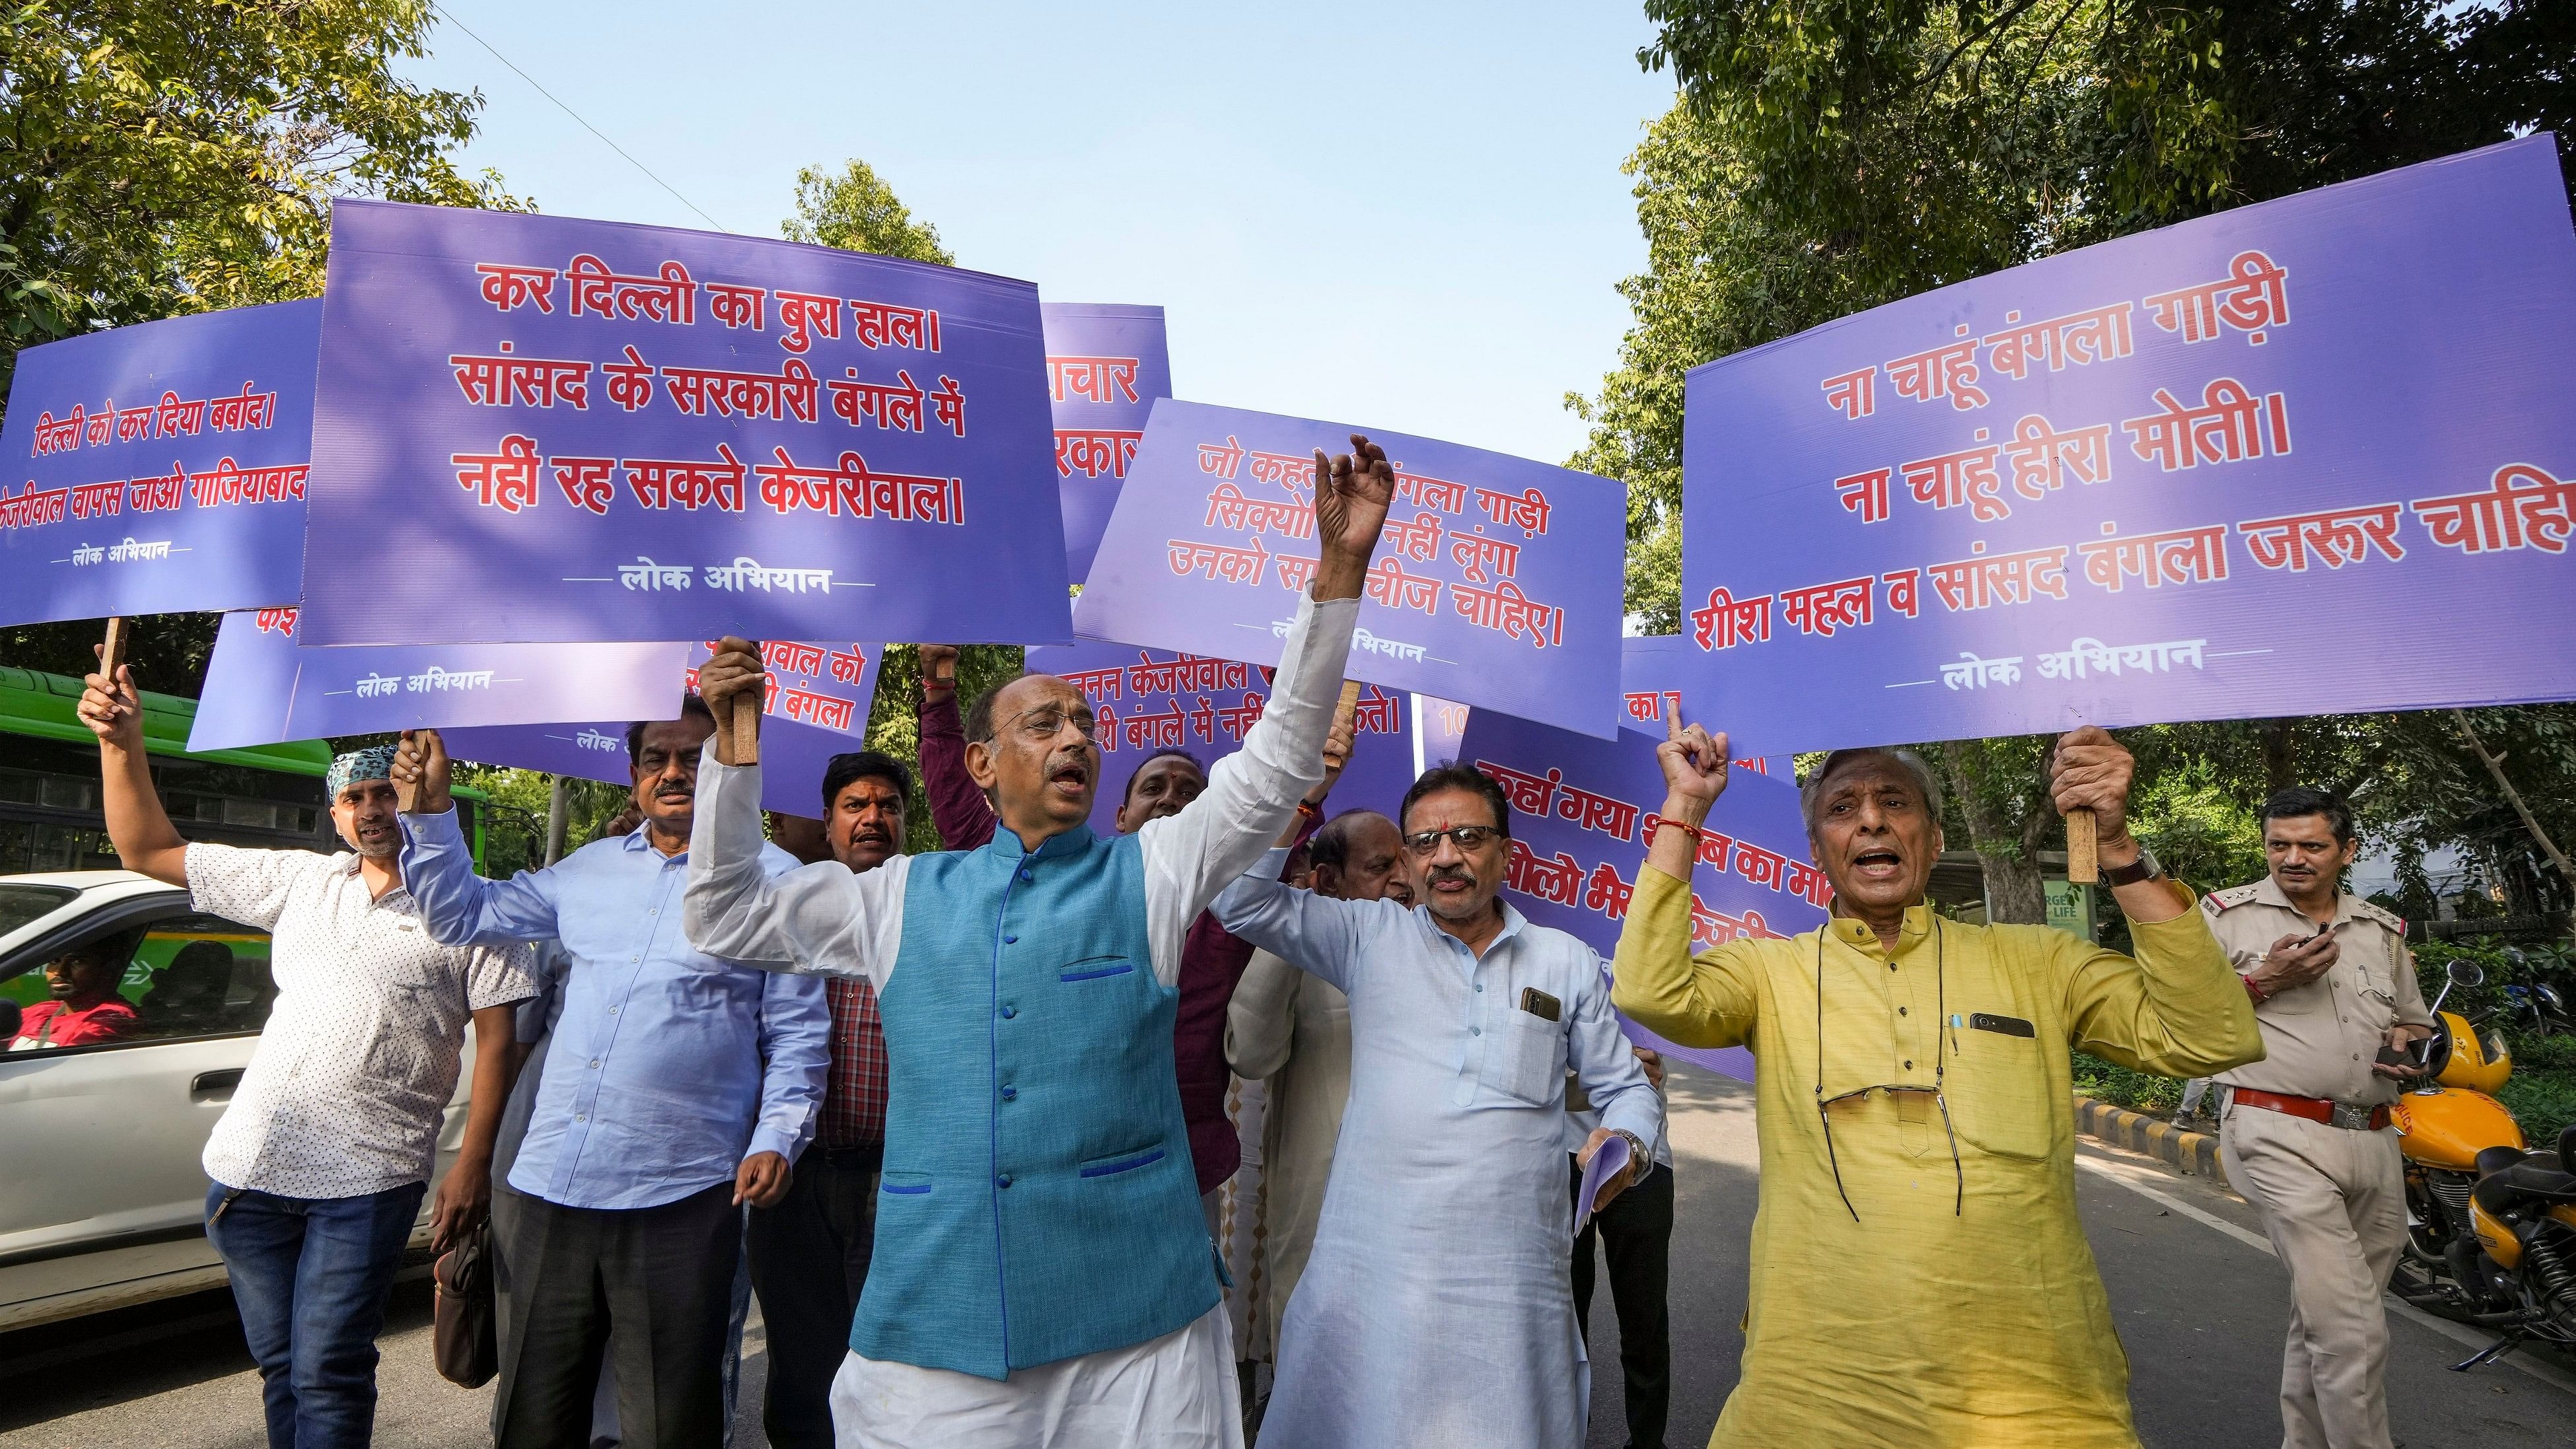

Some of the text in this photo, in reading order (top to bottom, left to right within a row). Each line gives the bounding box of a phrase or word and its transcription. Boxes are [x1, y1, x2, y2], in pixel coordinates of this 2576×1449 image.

[475, 253, 941, 354] कर दिल्ली का बुरा हाल।
[1822, 249, 2290, 421] ना चाहूं बंगला गाड़ी
[448, 341, 966, 439] सांसद के सरकारी बंगले में
[32, 400, 85, 458] दिल्ली
[88, 399, 115, 448] को
[118, 404, 153, 442] कर
[155, 390, 206, 439] दिया
[1835, 376, 2293, 524] ना चाहूं हीरा मोती।
[71, 480, 127, 520] वापस
[129, 460, 186, 513] जाओ
[190, 456, 311, 508] गाजियाबाद
[450, 433, 966, 526] नहीं रह सकते केजरीवाल।
[1197, 435, 1245, 479] जो
[1390, 462, 1468, 515] ंगला
[1474, 488, 1552, 538] गाड़ी
[73, 538, 171, 567] लोक अभियान
[618, 556, 833, 594] लोक अभियान
[1382, 512, 1443, 563] नहीं
[1449, 525, 1521, 584] लूंगा
[1691, 463, 2576, 653] शीश महल व सांसद बंगला जरूर चाहि
[1167, 536, 1270, 586] उनको
[1363, 555, 1443, 616] चीज
[1450, 581, 1565, 648] चाहिए।
[830, 643, 867, 686] को
[1129, 650, 1248, 697] केजरीवाल
[1352, 627, 1427, 663] भियान
[1939, 637, 2207, 691] लोक अभियान
[356, 665, 493, 698] लोक अभियान
[783, 681, 856, 730] बंगला
[1624, 692, 1660, 722] का
[577, 728, 620, 752] लोक
[1124, 698, 1187, 750] बंगले
[1191, 695, 1215, 743] में
[1557, 784, 1639, 843] गया
[1735, 839, 1786, 892] का
[2054, 907, 2076, 917] LIFE
